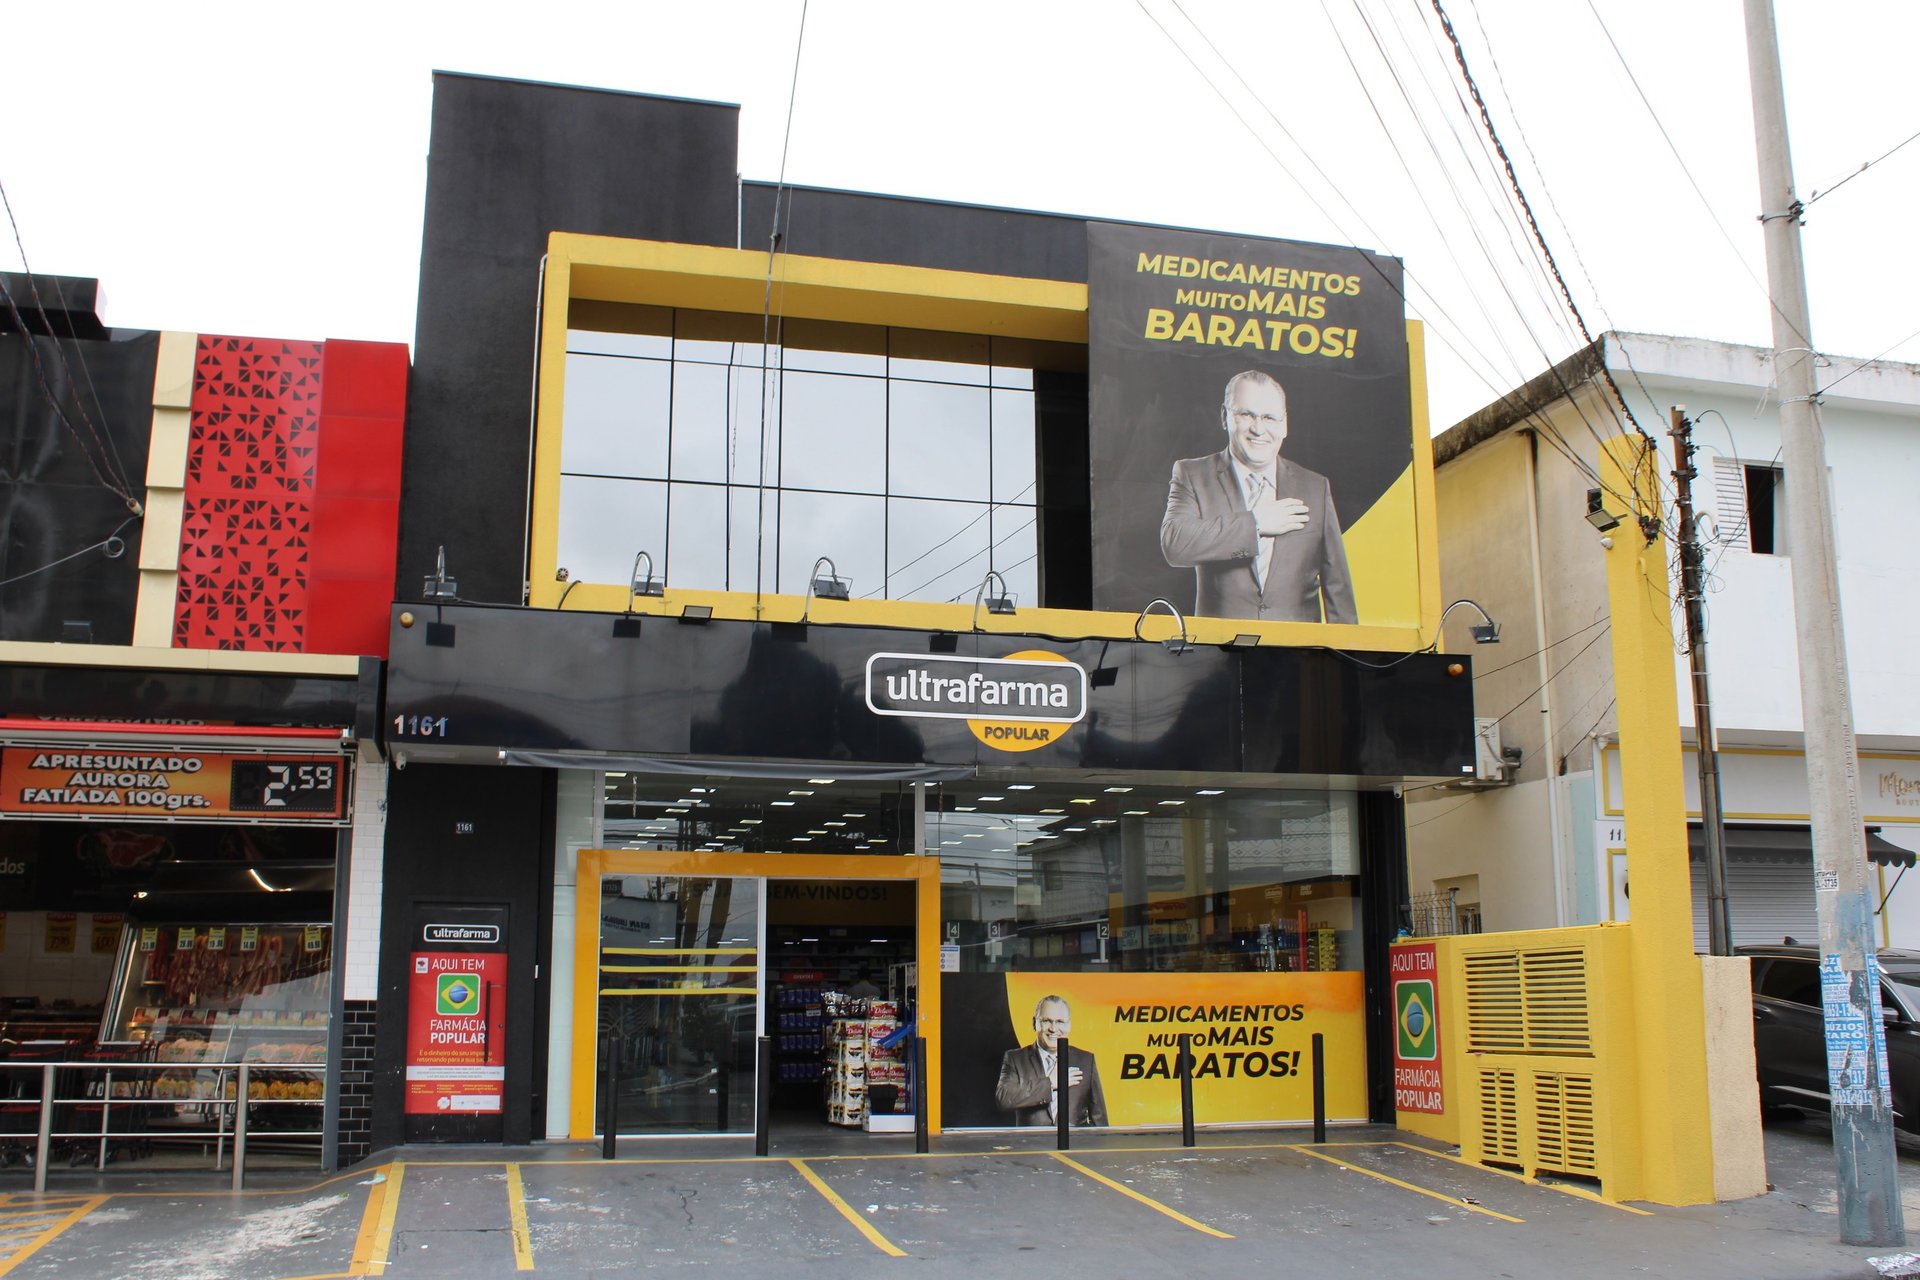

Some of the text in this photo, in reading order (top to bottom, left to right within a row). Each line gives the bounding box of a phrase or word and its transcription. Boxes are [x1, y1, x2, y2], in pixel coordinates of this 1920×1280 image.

[1136, 252, 1361, 296] MEDICAMENTOS
[1247, 289, 1327, 319] MAIS
[1144, 308, 1358, 359] BARATOS!
[886, 669, 1068, 708] ultrafarma
[394, 714, 447, 737] 1161
[984, 726, 1050, 741] POPULAR
[31, 753, 332, 806] APRESUNTADO 2.59
[68, 772, 170, 790] AURORA
[23, 788, 212, 810] FATIADA 100grs.
[456, 823, 472, 832] 1161
[433, 928, 491, 939] ultrafarma
[950, 925, 958, 935] 4
[991, 925, 998, 935] 3
[1101, 926, 1108, 936] 2
[431, 958, 485, 971] AQUI TEM
[1392, 952, 1435, 972] AQUI TEM
[430, 1016, 487, 1031] FARMÁCIA
[1114, 1004, 1305, 1023] MEDICAMENTOS
[430, 1032, 486, 1044] POPULAR
[1207, 1026, 1275, 1047] MAIS
[1120, 1051, 1301, 1080] BARATOS!
[1394, 1066, 1441, 1088] FARMÁCIA
[1395, 1089, 1442, 1110] POPULAR
